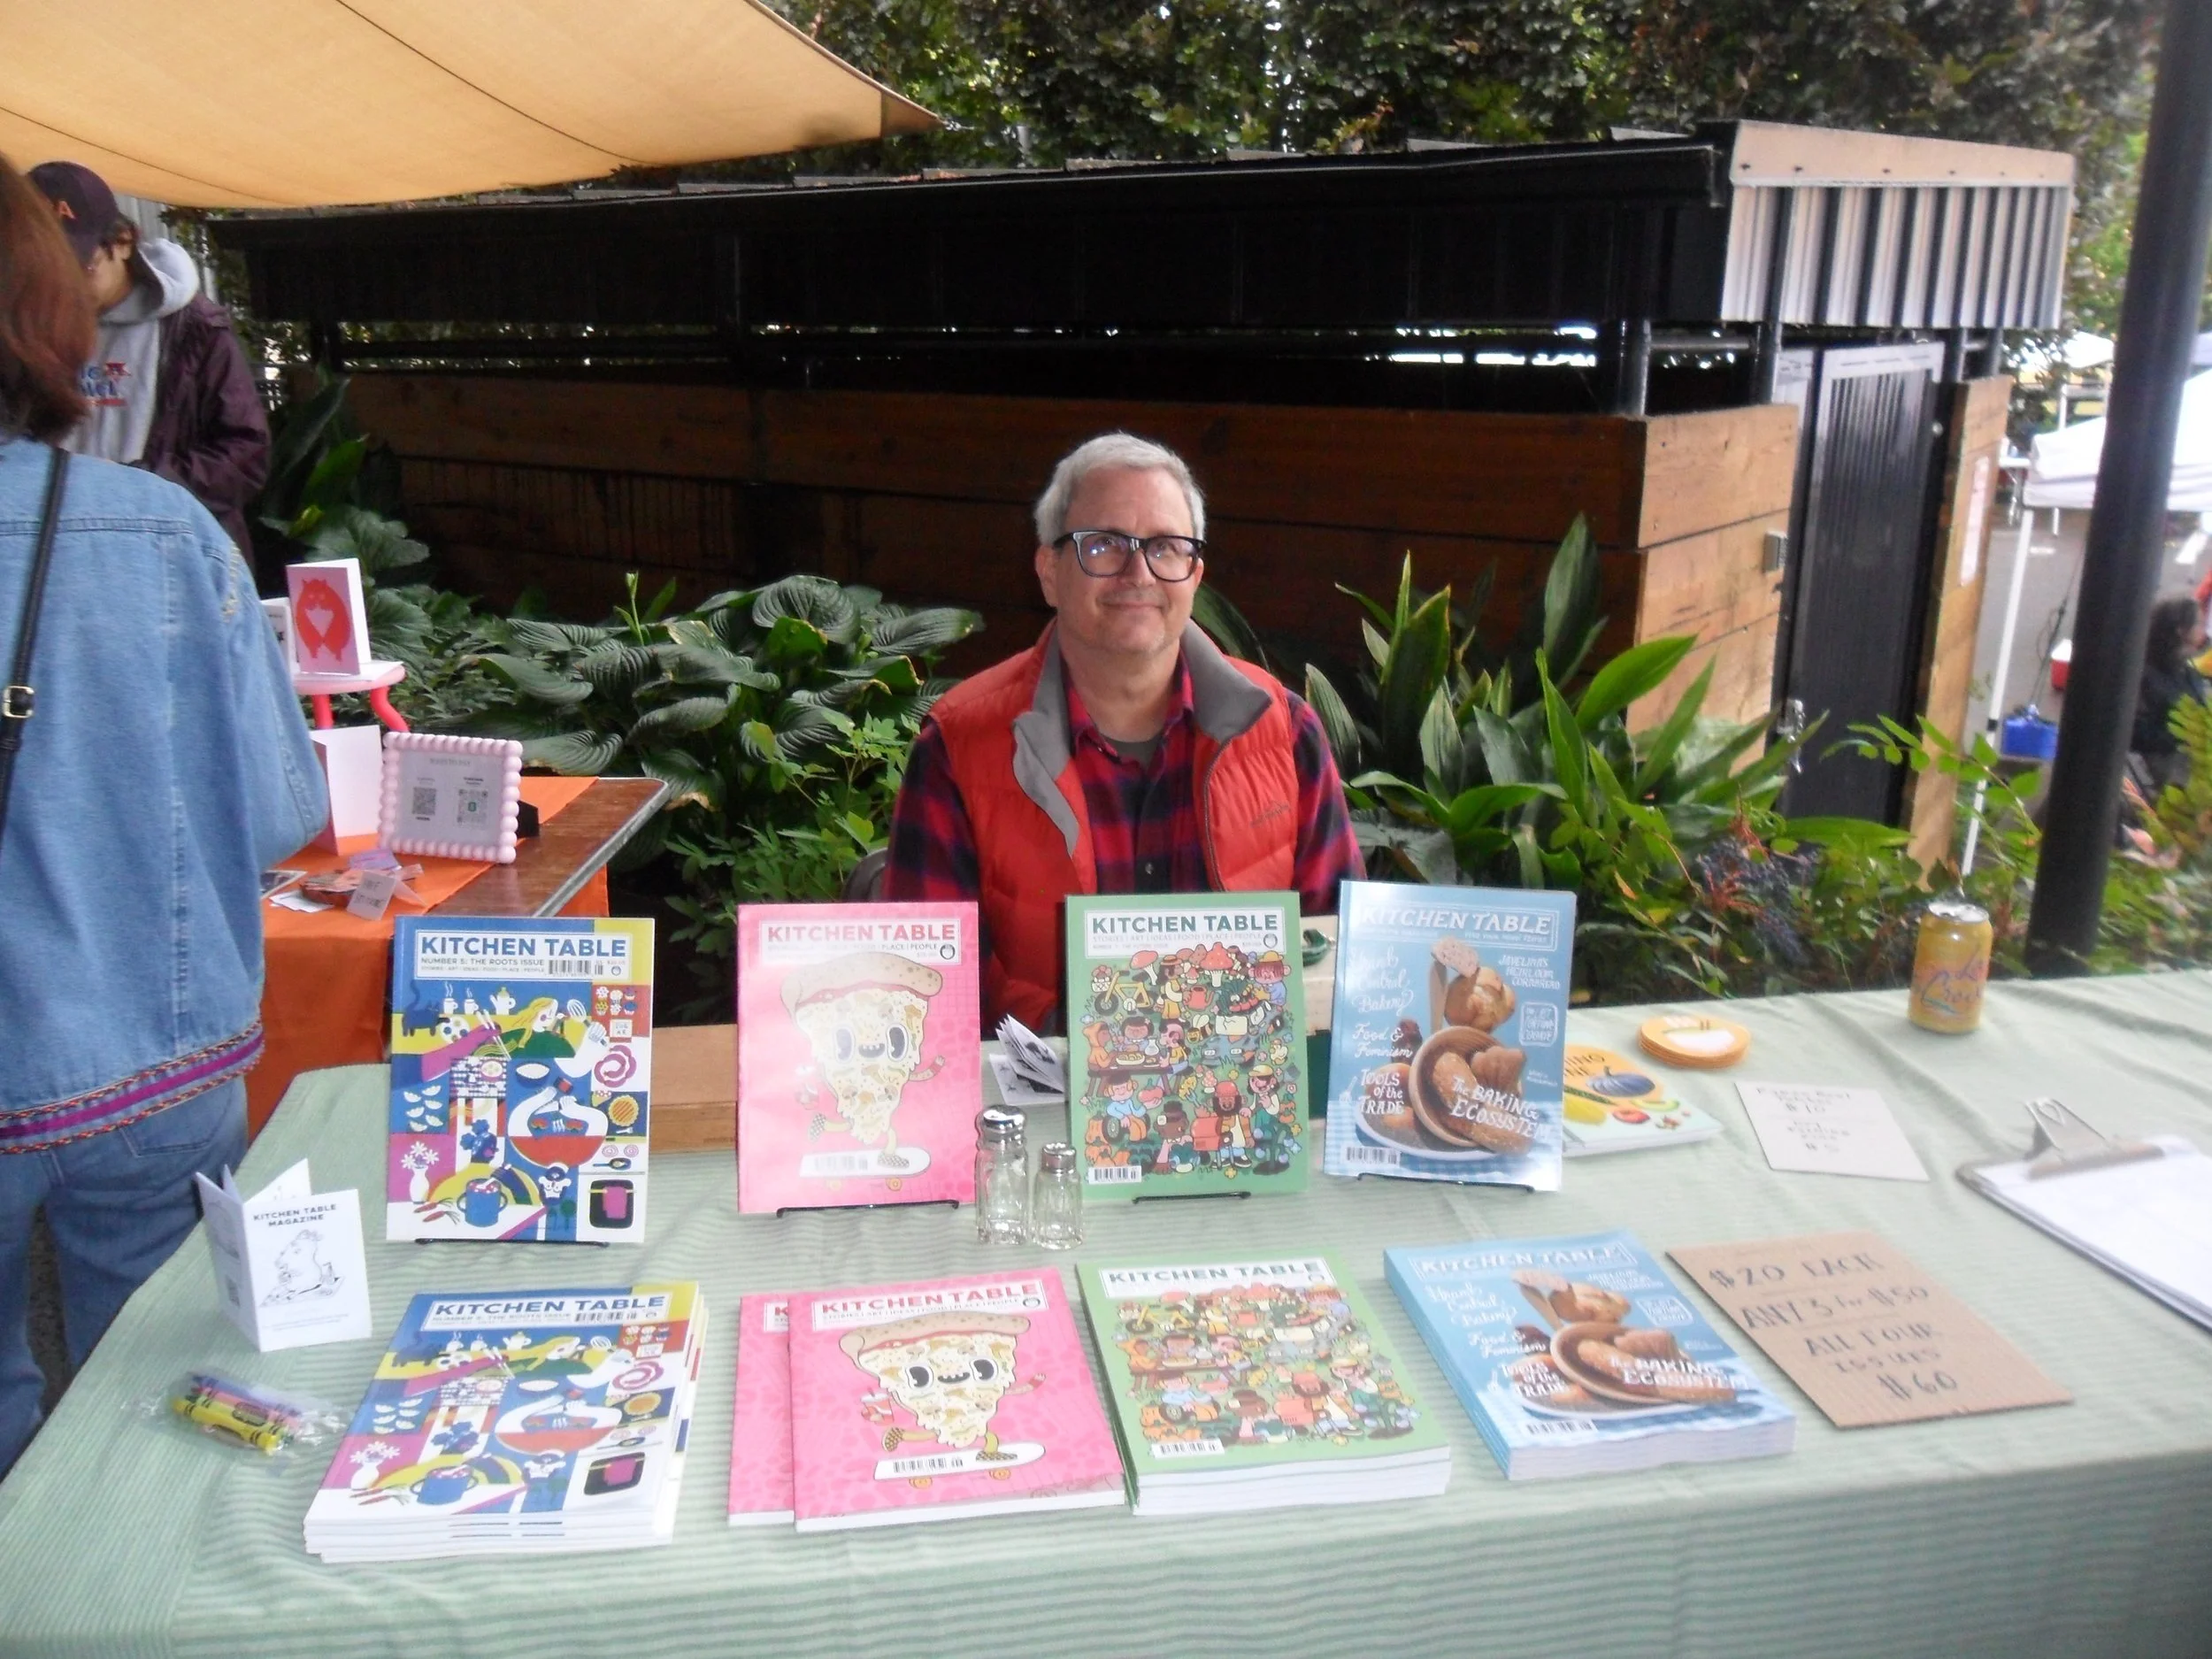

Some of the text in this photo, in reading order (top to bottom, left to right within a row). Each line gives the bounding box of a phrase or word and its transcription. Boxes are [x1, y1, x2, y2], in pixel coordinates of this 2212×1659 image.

[1093, 914, 1278, 933] KITCHEN TABLE
[1360, 906, 1552, 934] KITCHEN TABLE
[768, 924, 956, 942] KITCHEN TABLE
[421, 936, 626, 957] KITCHEN TABLE
[1352, 1021, 1404, 1042] Food &
[1361, 1068, 1401, 1087] TOOLS
[1373, 1086, 1403, 1099] of the
[1358, 1095, 1405, 1115] TRADE
[253, 1203, 336, 1221] KITCHEN TABLE
[268, 1213, 324, 1226] MAGAZINE
[1420, 1251, 1534, 1273] KITCHEN
[1709, 1253, 1886, 1288] $20 EACH
[1109, 1263, 1322, 1284] KITCHEN TABLE
[434, 1296, 665, 1316] KITCHEN TABLE
[822, 1284, 1038, 1314] KITCHEN TABLE
[1740, 1300, 1804, 1328] ANY
[1809, 1297, 1834, 1317] 3
[1867, 1285, 1930, 1308] $50
[1804, 1333, 1855, 1356] ALL
[1876, 1370, 1958, 1401] $60
